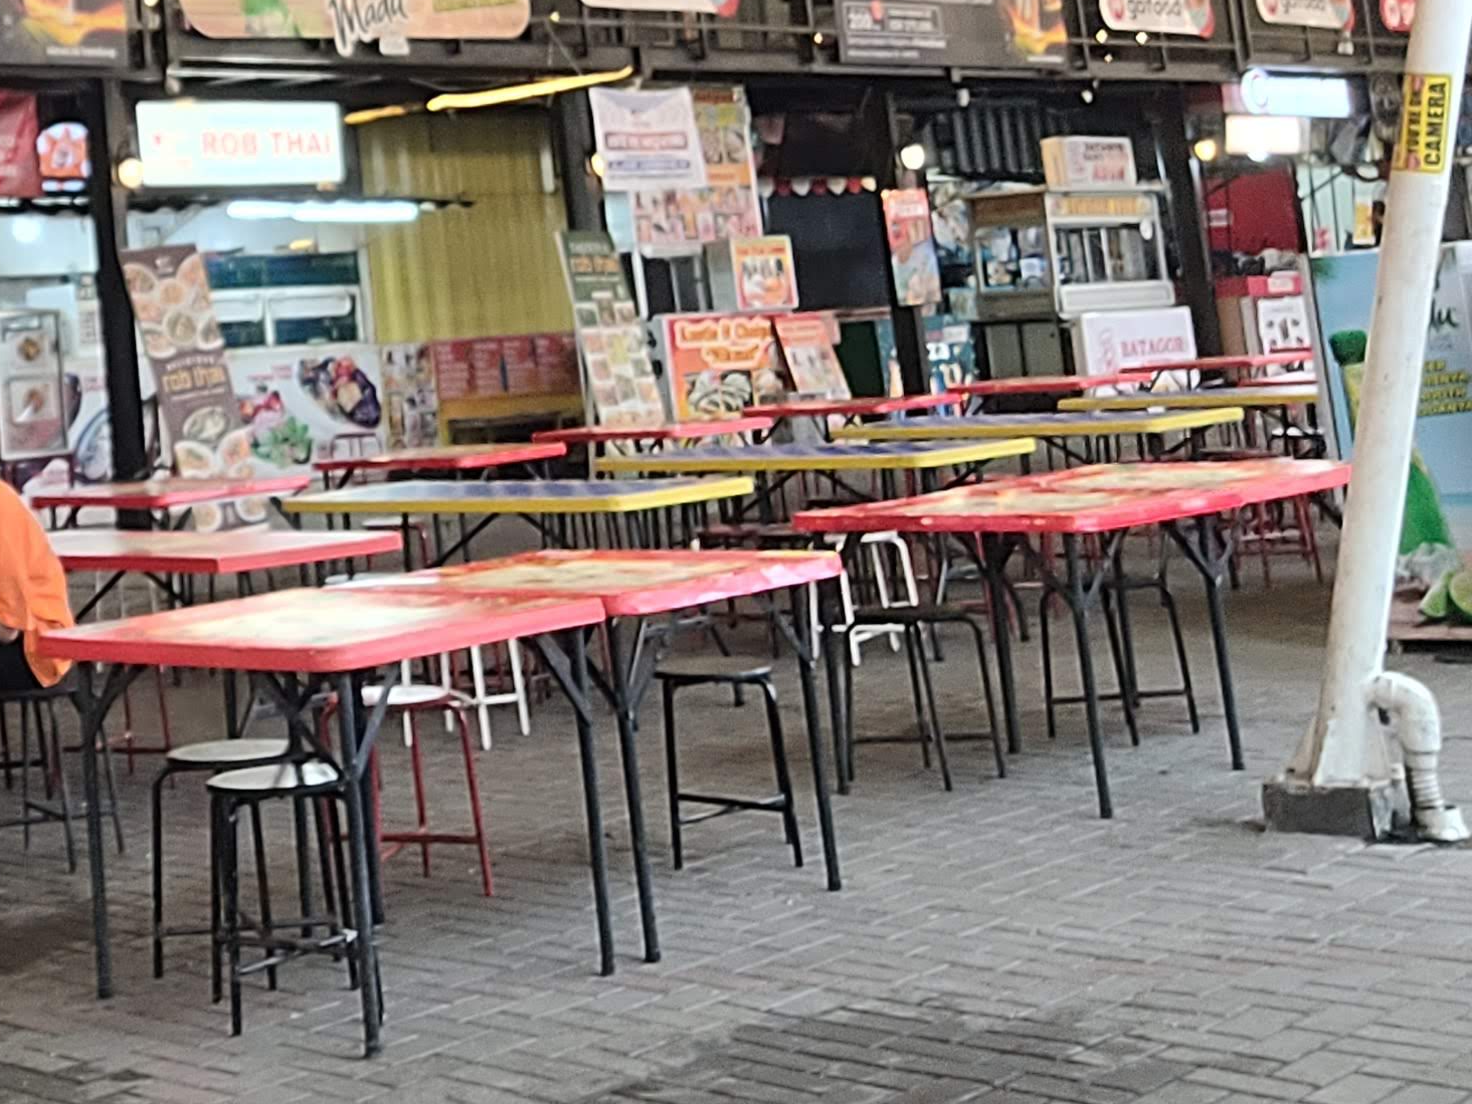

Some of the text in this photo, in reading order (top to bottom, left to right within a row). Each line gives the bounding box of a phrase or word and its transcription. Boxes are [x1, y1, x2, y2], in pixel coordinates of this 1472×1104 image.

[201, 130, 331, 156] ROB THAI
[1424, 83, 1446, 165] CAMERA
